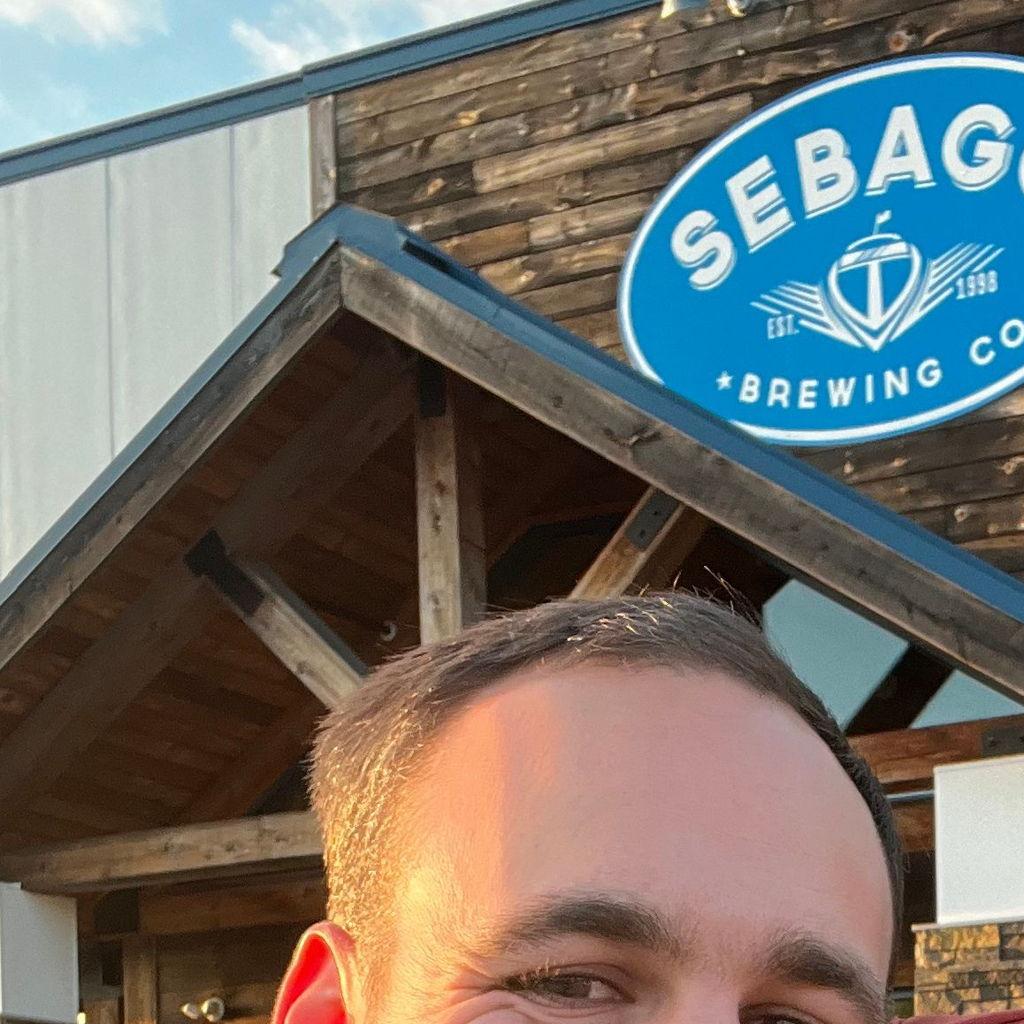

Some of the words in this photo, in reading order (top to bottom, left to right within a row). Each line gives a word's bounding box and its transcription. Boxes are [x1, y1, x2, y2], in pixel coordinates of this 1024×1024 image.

[767, 314, 800, 340] EST.
[956, 270, 998, 299] 1998
[738, 358, 942, 408] BREWING
